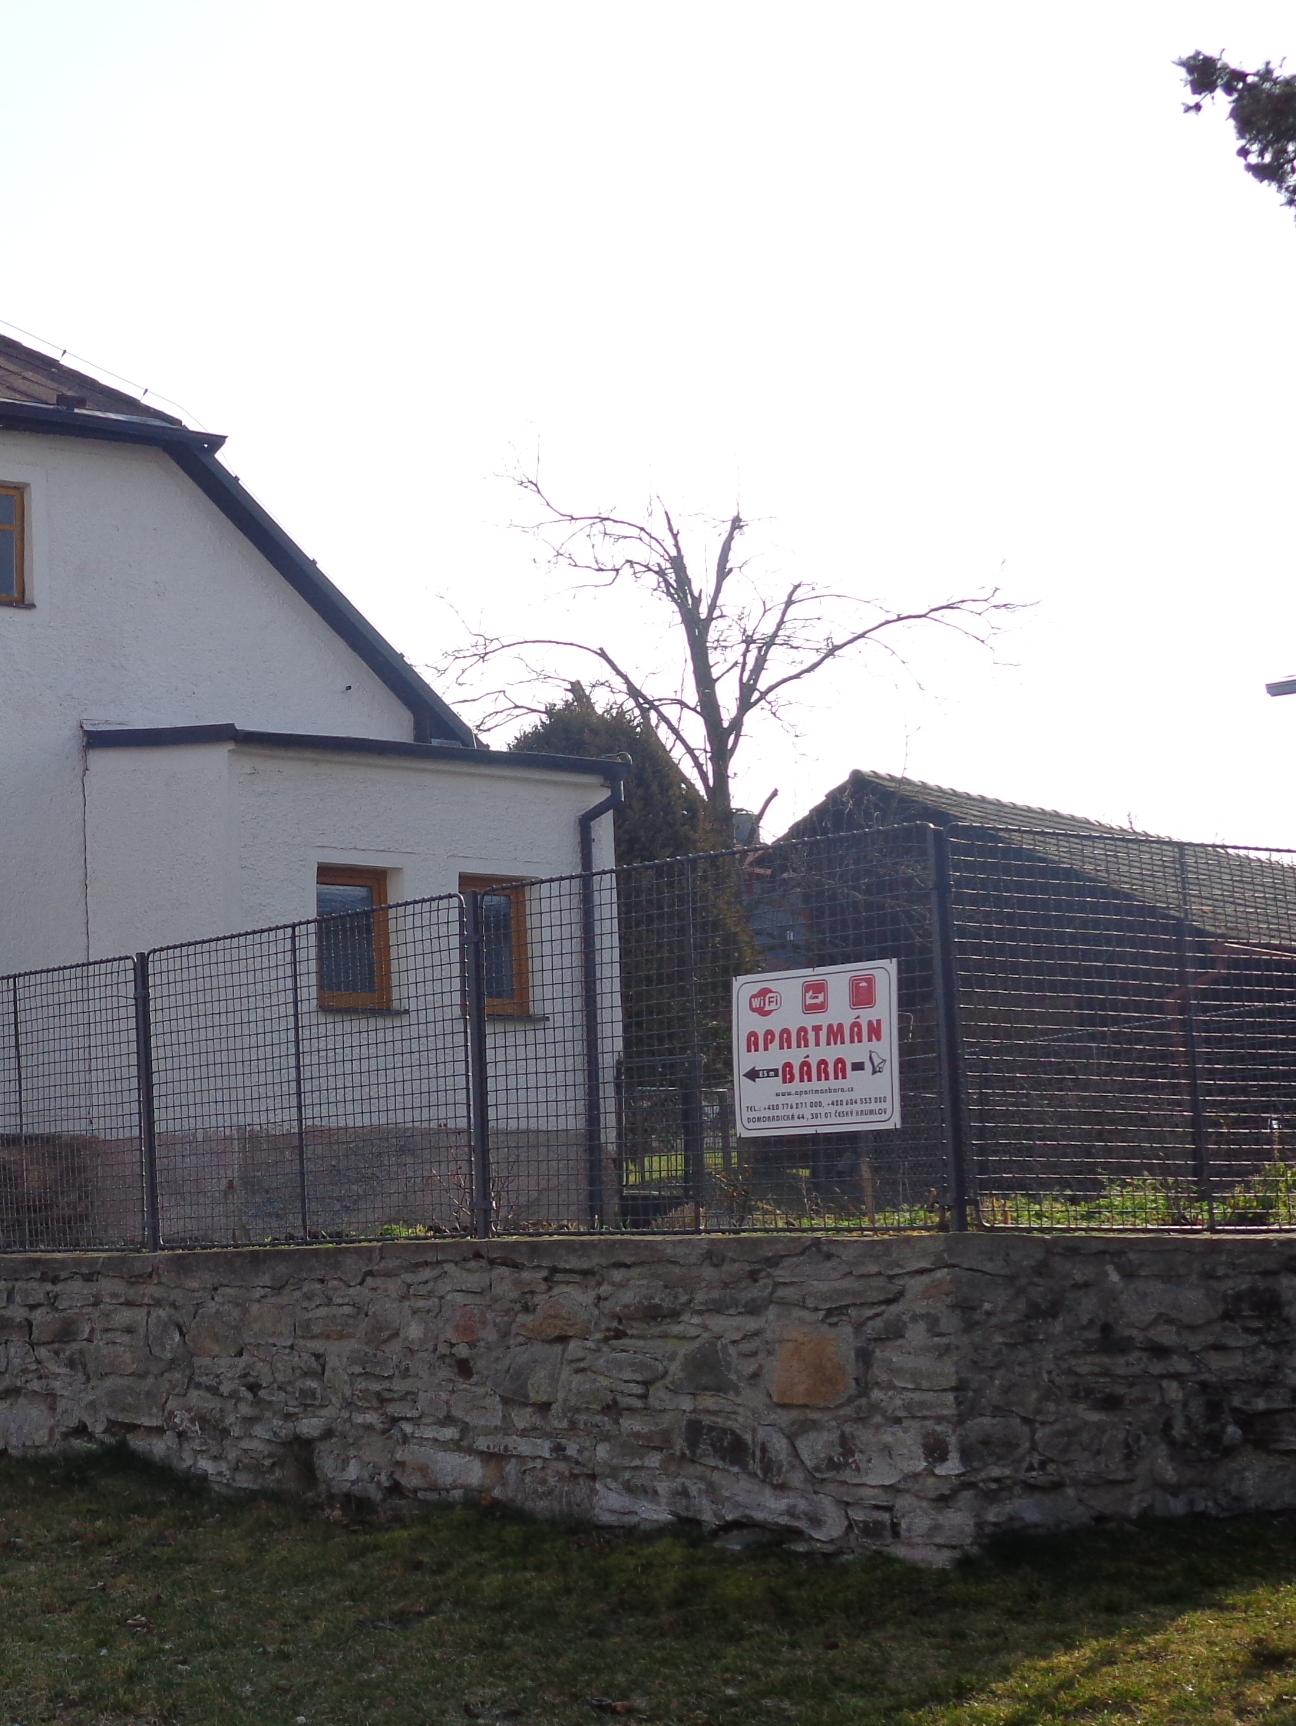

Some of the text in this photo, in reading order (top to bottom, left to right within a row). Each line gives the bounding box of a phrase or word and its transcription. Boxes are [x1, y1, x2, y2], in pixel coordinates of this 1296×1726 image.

[751, 995, 778, 1009] WiFi
[745, 1015, 883, 1053] APARTMÁN
[781, 1054, 848, 1085] BÁRA
